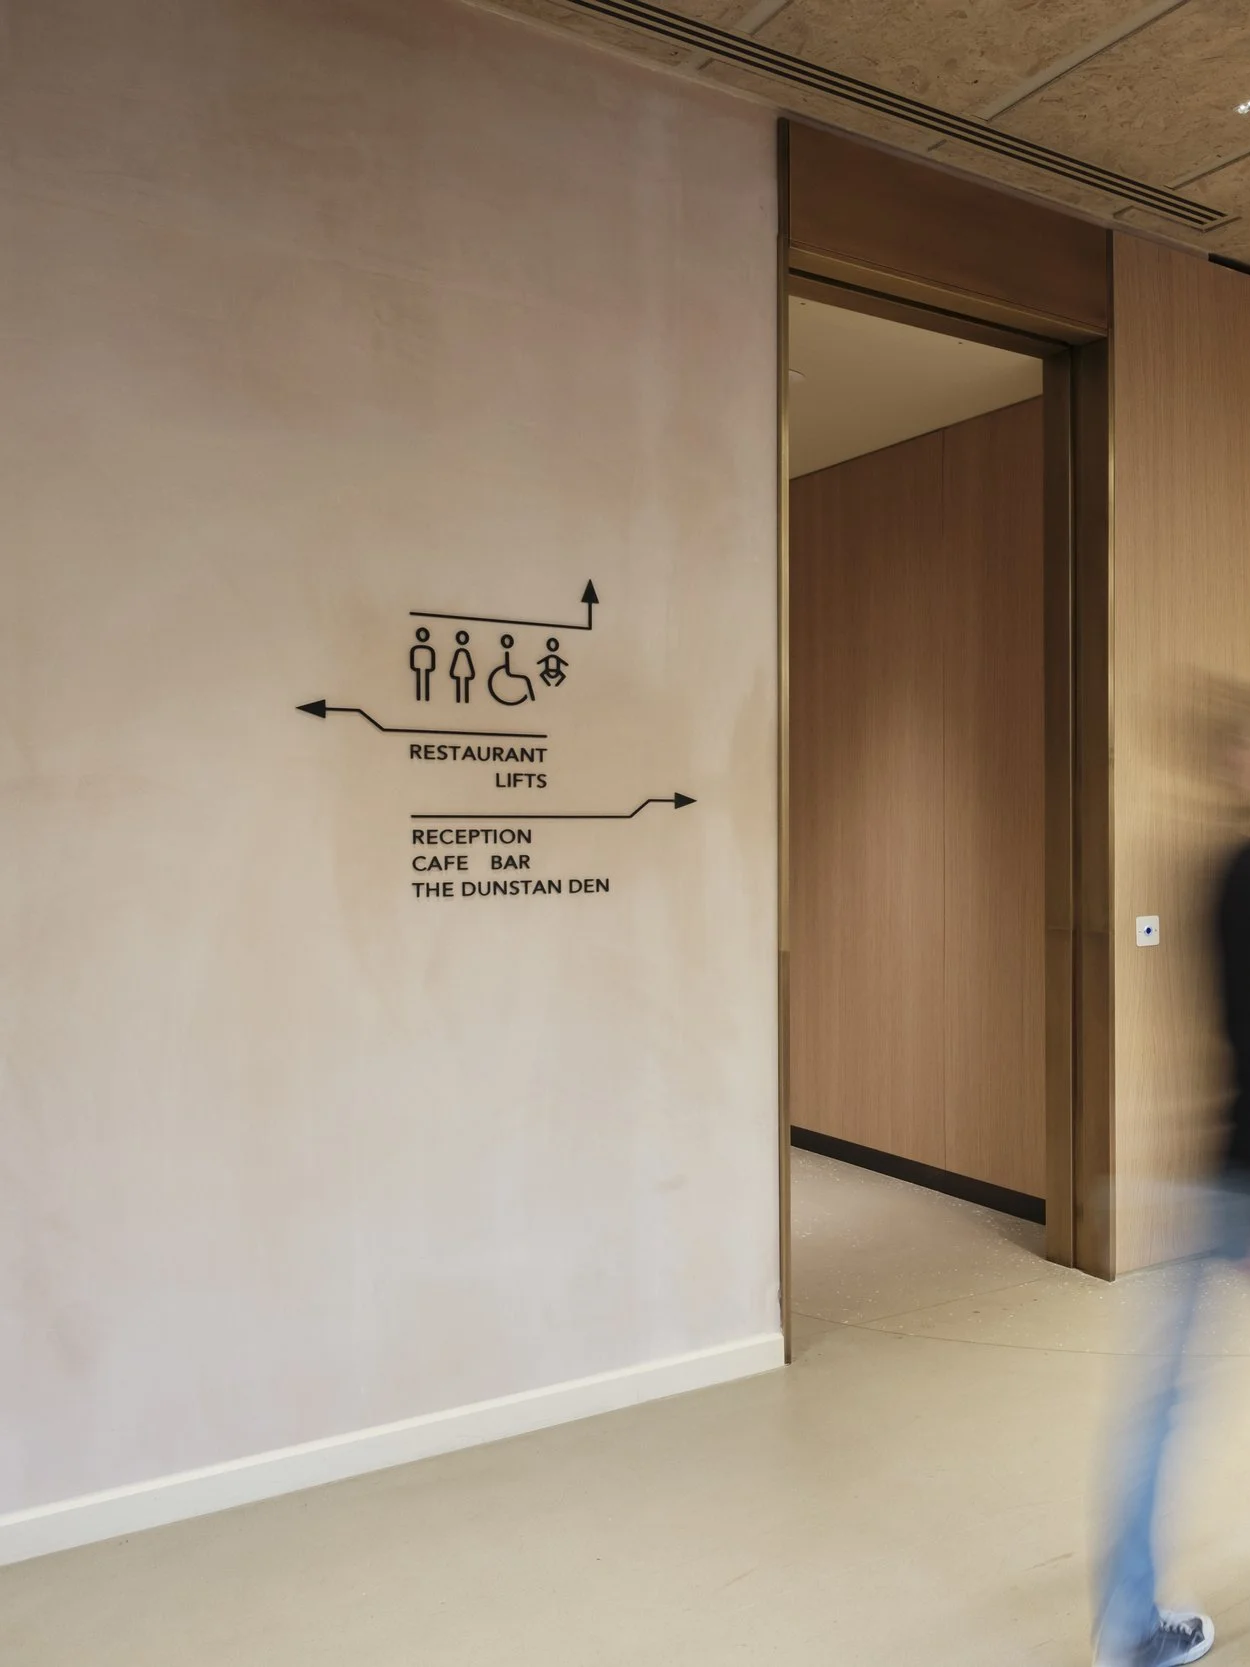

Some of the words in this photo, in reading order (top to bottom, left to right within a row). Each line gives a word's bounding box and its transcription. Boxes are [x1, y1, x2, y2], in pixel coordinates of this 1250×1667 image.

[409, 743, 548, 763] RESTAURANT
[495, 772, 548, 789] LIFTS
[411, 828, 532, 845] RECEPTION
[411, 855, 469, 872] CAFE
[490, 854, 531, 871] BAR
[411, 881, 455, 898] THE
[461, 879, 562, 897] DUNSTAN
[568, 877, 610, 894] DEN
